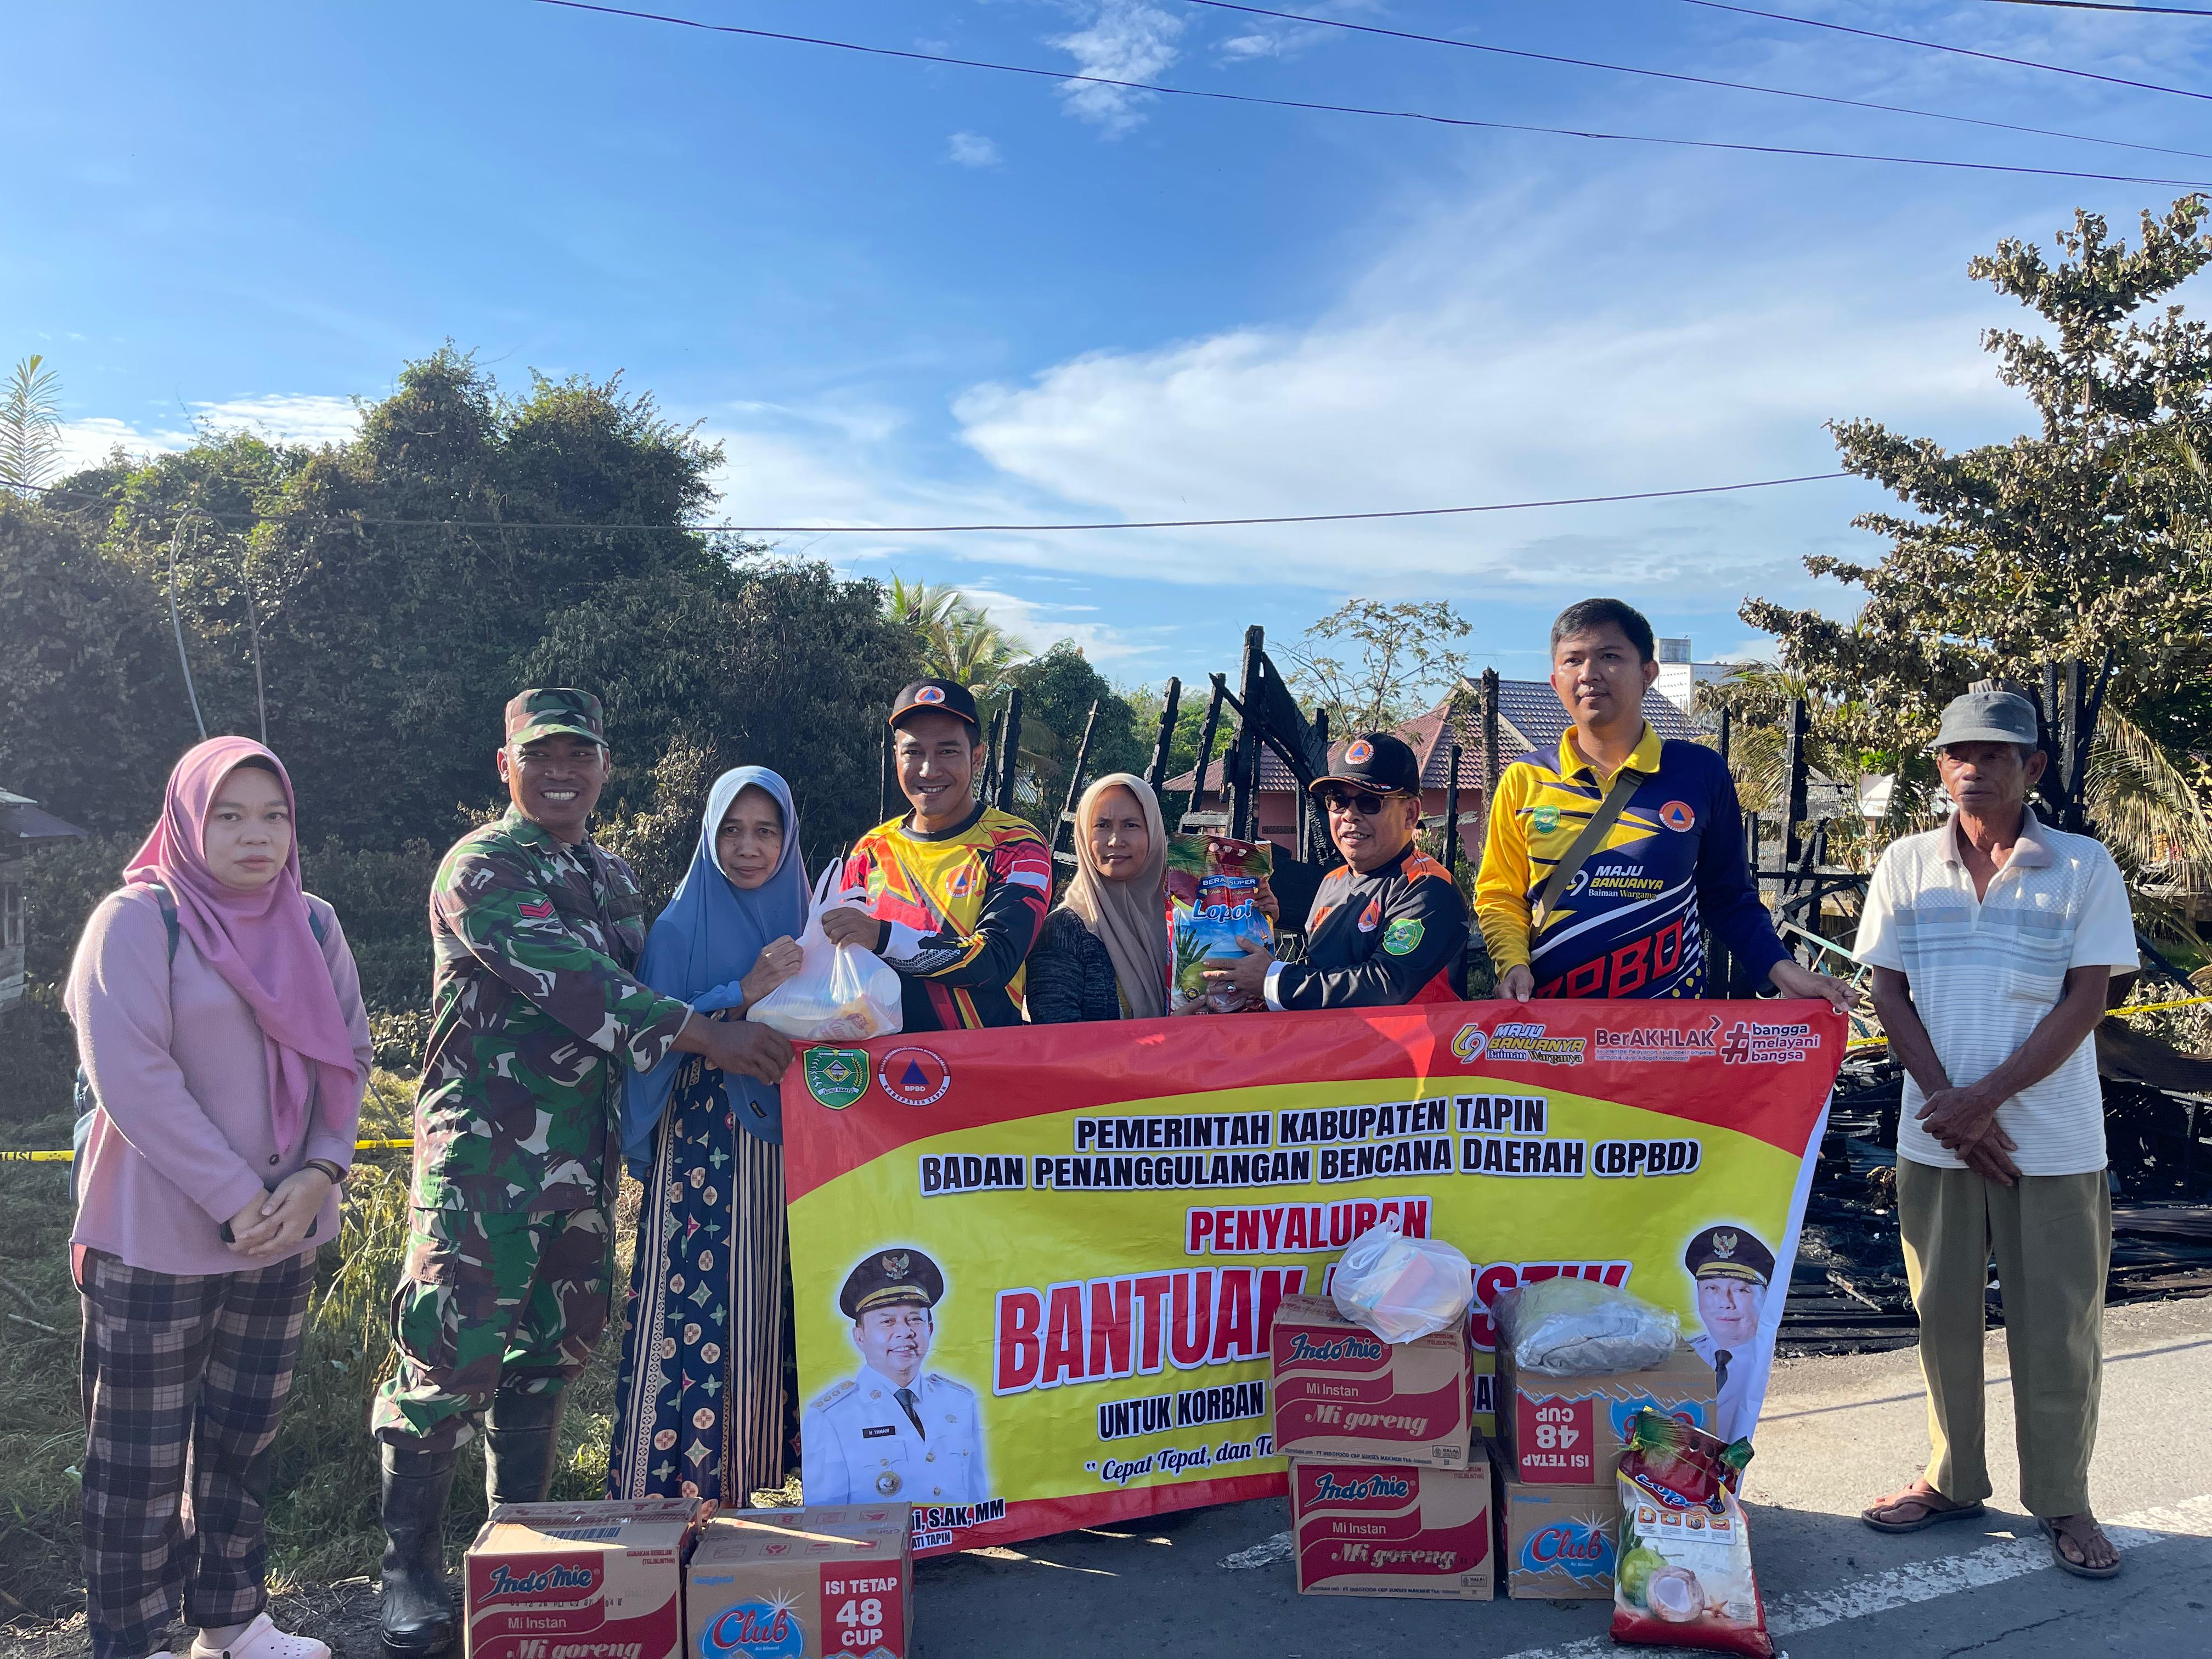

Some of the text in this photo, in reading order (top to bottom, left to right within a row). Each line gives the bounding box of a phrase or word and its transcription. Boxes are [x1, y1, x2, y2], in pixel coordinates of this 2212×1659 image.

[1595, 865, 1644, 876] MAJU
[1203, 877, 1226, 885] BERA
[1590, 878, 1664, 890] BANUANYA
[1620, 890, 1657, 900] Warganya
[1494, 1025, 1544, 1037] MAJU
[1596, 1030, 1714, 1046] BerAKHLAK
[1753, 1024, 1808, 1036] bangga
[1487, 1037, 1585, 1052] BANUANYA
[1753, 1035, 1818, 1049] melayani
[1487, 1049, 1582, 1064] Baiman Warganya
[1752, 1051, 1803, 1062] bangsa
[927, 1086, 946, 1104] TAPIN
[1078, 1098, 1543, 1149] PEMERINTAH KABUPATEN TAPIN
[923, 1138, 1699, 1192] BADAN PENANGGULANGAN BENCANA DAERAH (BPBD)
[998, 1270, 1304, 1389] BANTUAN
[1306, 1382, 1358, 1397] Mi Instan
[1100, 1381, 1263, 1438] UNTUK KORBAN
[1536, 1407, 1574, 1422] CUP
[1305, 1404, 1429, 1436] Mi goreng
[1537, 1425, 1579, 1449] 48
[1102, 1456, 1153, 1483] Cepat
[1158, 1446, 1211, 1474] Tepat,
[1216, 1442, 1251, 1462] dan
[1522, 1454, 1589, 1467] ISI TETAP
[975, 1498, 1004, 1522] MM
[1333, 1522, 1386, 1534] Mi Instan
[927, 1532, 951, 1545] TAPIN
[1532, 1529, 1602, 1562] Club
[1331, 1543, 1369, 1562] Mi
[1370, 1549, 1457, 1570] goreng
[825, 1577, 897, 1594] ISI TETAP
[836, 1599, 883, 1627] 48
[509, 1617, 566, 1629] Mi Instan
[713, 1609, 788, 1649] Club
[842, 1628, 883, 1646] CUP
[506, 1639, 644, 1659] Mi goreng
